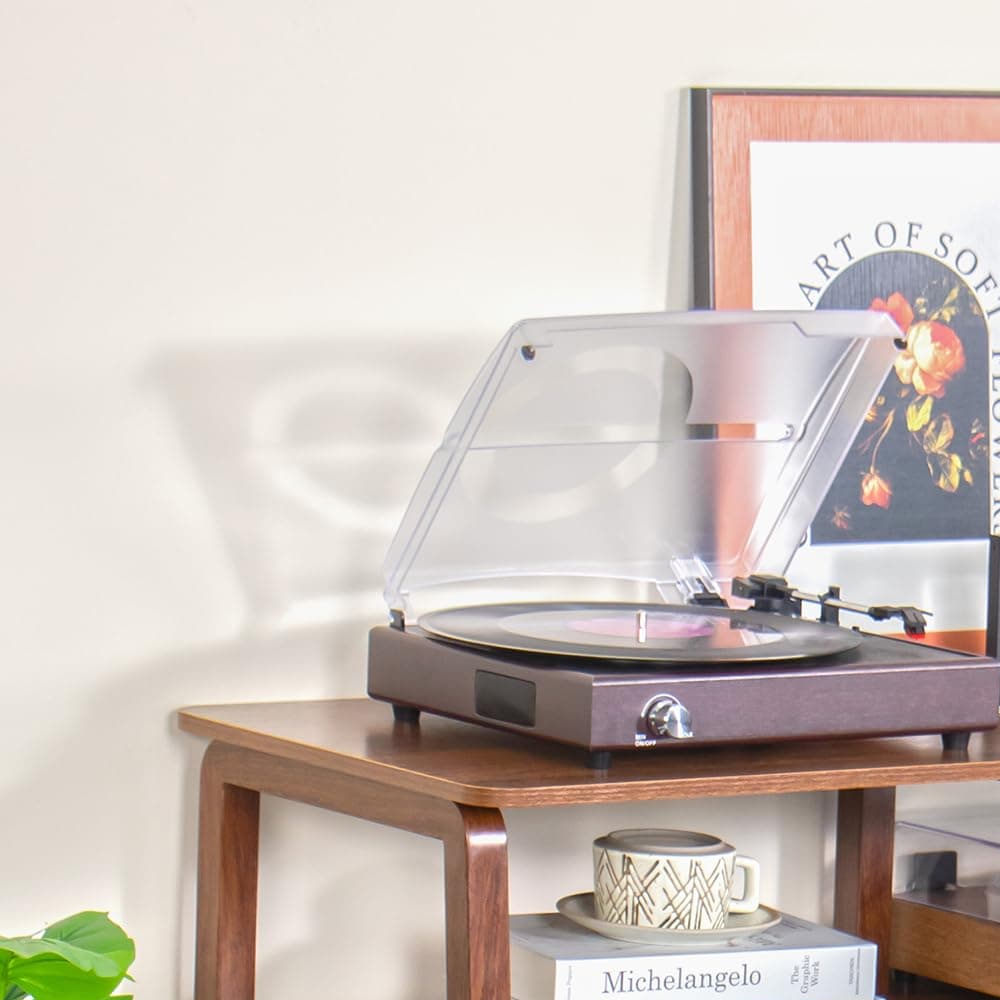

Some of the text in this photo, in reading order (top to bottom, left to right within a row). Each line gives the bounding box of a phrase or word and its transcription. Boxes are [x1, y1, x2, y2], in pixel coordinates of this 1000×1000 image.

[798, 233, 856, 306] ART
[874, 221, 922, 248] OF
[602, 963, 761, 993] Michelangelo
